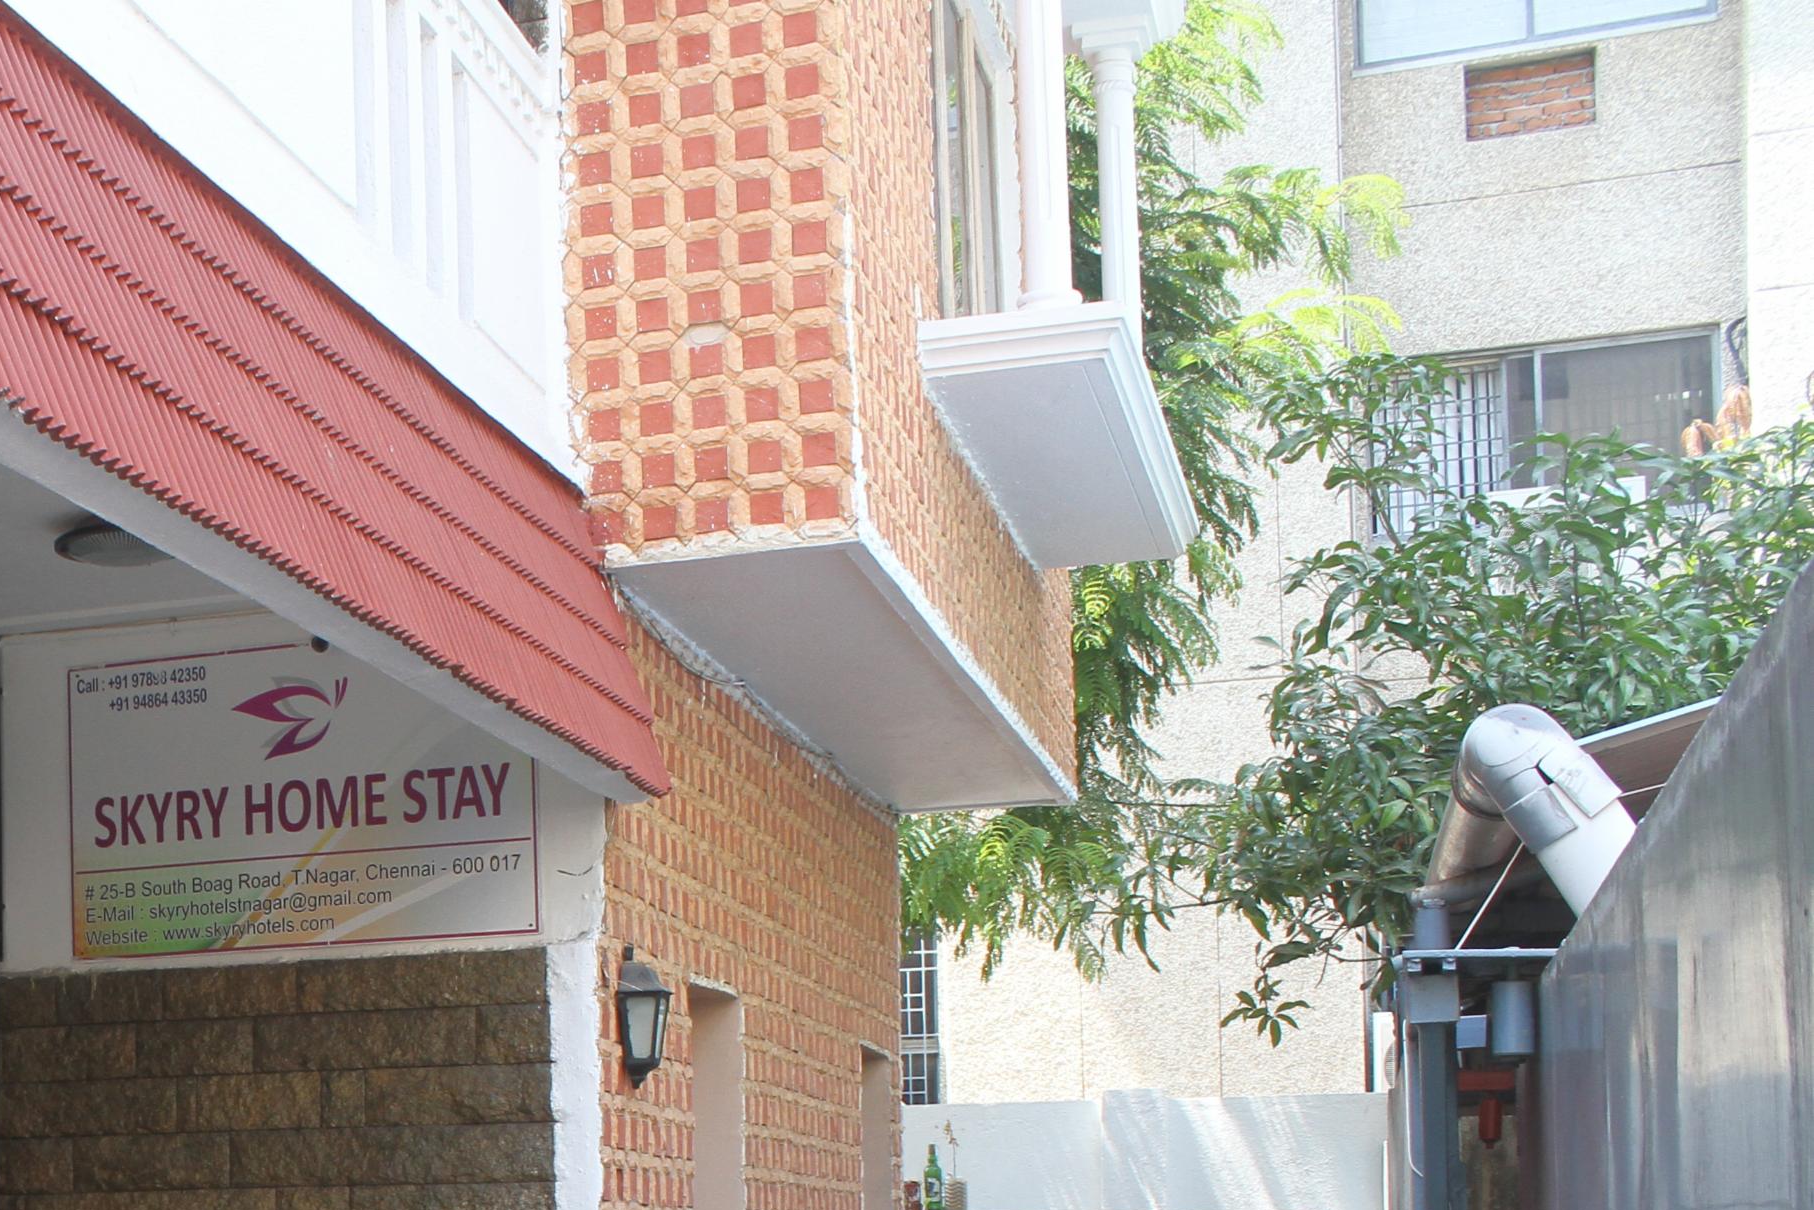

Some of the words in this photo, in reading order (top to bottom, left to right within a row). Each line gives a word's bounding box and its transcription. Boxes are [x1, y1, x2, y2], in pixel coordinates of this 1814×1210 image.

[77, 677, 98, 694] Call
[108, 675, 128, 690] +91
[170, 666, 206, 684] 42350
[109, 697, 129, 711] +91
[133, 692, 168, 710] 94864
[171, 688, 207, 705] 43350
[94, 786, 229, 848] SKYRY
[244, 773, 387, 836] HOME
[402, 762, 510, 824] STAY
[100, 882, 136, 900] 25-B
[141, 879, 186, 897] South
[192, 876, 233, 895] Boag
[365, 860, 435, 881] Chennai
[452, 856, 484, 875] 600
[489, 854, 521, 873] 017
[86, 906, 135, 923] E-Mail
[149, 889, 393, 922] skyryhotelstnagar@gmail.com
[86, 929, 149, 946] Website
[163, 916, 335, 943] www.skyryhotels.com
